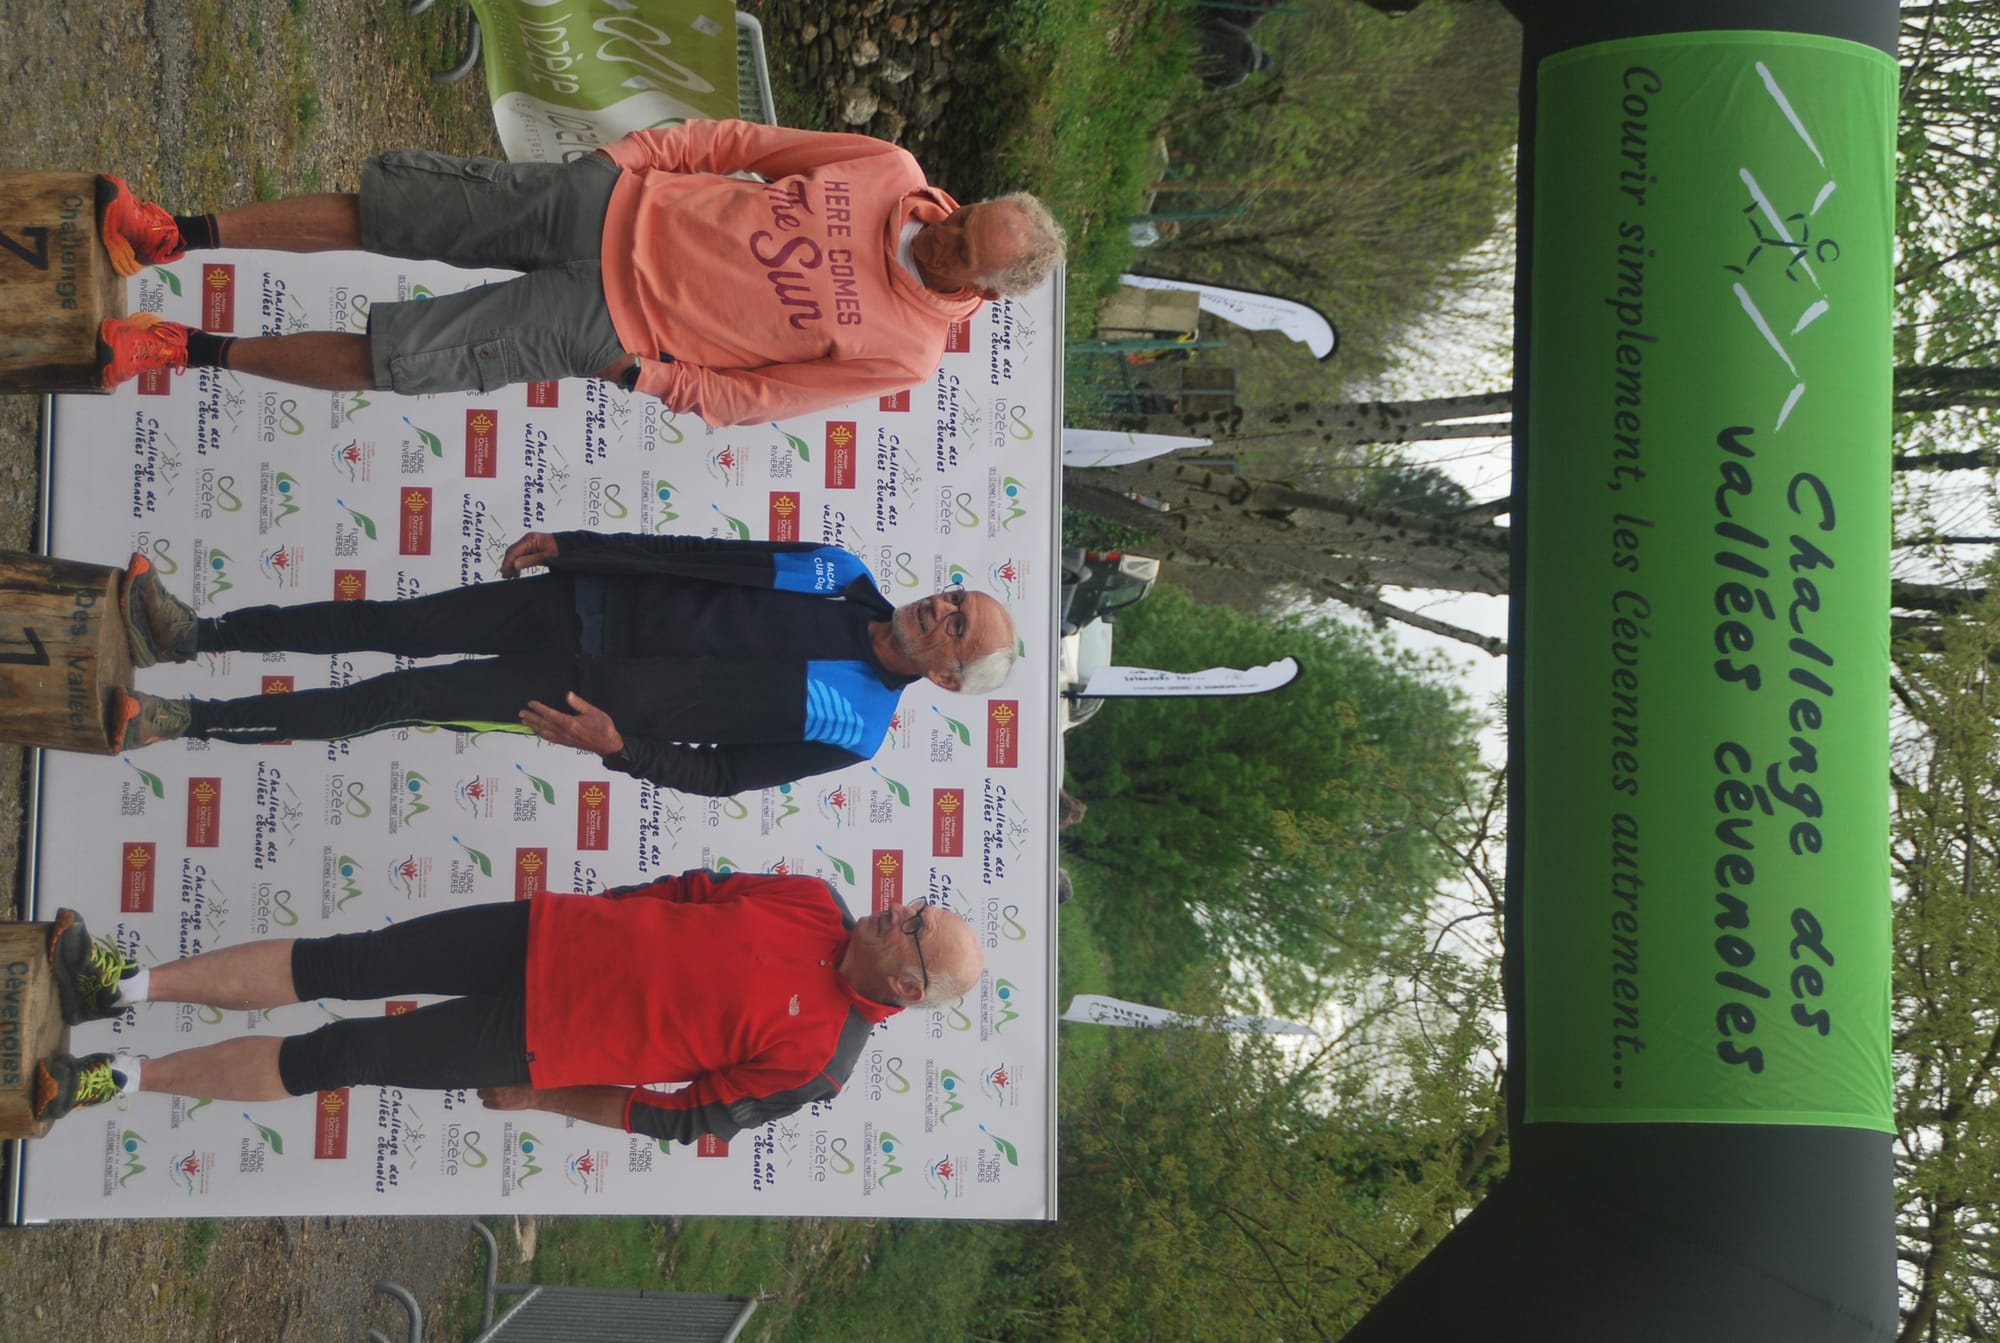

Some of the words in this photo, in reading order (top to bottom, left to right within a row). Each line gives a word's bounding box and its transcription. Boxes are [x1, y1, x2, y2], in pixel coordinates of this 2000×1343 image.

[1614, 66, 1661, 206] Courir
[762, 180, 816, 232] The
[824, 181, 851, 237] HERE
[55, 195, 84, 310] Challenge
[262, 272, 273, 316] vallées
[750, 230, 823, 330] Sun
[828, 249, 861, 325] COMES
[214, 292, 222, 329] Occitanie
[272, 280, 285, 336] Challeng
[992, 302, 1002, 324] lées
[1002, 299, 1013, 350] hallenge
[991, 332, 1001, 386] cévenoles
[1003, 359, 1012, 379] des
[1605, 221, 1654, 493] simplement,
[209, 367, 222, 420] hallenge
[937, 368, 948, 411] vallées
[946, 375, 960, 438] Challenge
[135, 411, 146, 456] vallées
[198, 400, 209, 455] cévenoles
[211, 428, 220, 449] des
[264, 392, 278, 442] lozère
[585, 410, 595, 465] cévenoles
[645, 401, 658, 451] lozère
[995, 398, 1008, 447] lozère
[145, 418, 159, 482] Challenge
[525, 423, 535, 467] vallées
[533, 430, 547, 494] Challenge
[598, 438, 607, 458] des
[877, 427, 887, 470] vallées
[885, 435, 900, 498] Challenge
[936, 419, 947, 472] cévenoles
[949, 446, 958, 466] des
[133, 463, 146, 518] cévenoles
[147, 491, 156, 512] des
[201, 468, 215, 518] lozère
[462, 494, 472, 536] vallées
[524, 475, 534, 529] cévenoles
[536, 502, 544, 522] des
[589, 477, 602, 526] lozère
[876, 478, 887, 532] cévenoles
[889, 505, 897, 525] des
[941, 485, 954, 534] lozère
[473, 501, 485, 564] Challenge
[835, 512, 844, 547] Chall
[1611, 514, 1653, 572] les
[461, 545, 471, 586] cévenol
[880, 545, 893, 594] lozère
[1714, 427, 1778, 692] vallées
[70, 592, 96, 636] Des
[0, 627, 50, 665] 1
[1766, 472, 1836, 856] Challenge
[1609, 591, 1654, 794] Cévennes
[137, 786, 145, 816] FLORAC
[257, 761, 268, 806] vallées
[266, 768, 280, 833] Challenge
[330, 774, 345, 825] lozère
[984, 778, 994, 822] vallées
[589, 810, 597, 847] Occitanie
[649, 784, 661, 836] hallenge
[993, 785, 1006, 849] Challenge
[254, 814, 268, 870] cévenoles
[268, 841, 277, 862] des
[639, 818, 649, 873] cévenoles
[652, 845, 660, 866] des
[983, 830, 994, 885] cévenoles
[134, 871, 142, 909] Occitanie
[182, 858, 192, 902] vallées
[929, 867, 939, 906] vallée
[942, 874, 951, 911] Chall
[996, 857, 1004, 878] des
[190, 865, 206, 930] Challenge
[257, 883, 272, 934] lozère
[1714, 741, 1779, 1073] cévenoles
[192, 939, 202, 954] de
[987, 898, 1000, 948] lozère
[1609, 812, 1648, 1092] autrement...
[1789, 907, 1832, 1036] des
[2, 961, 30, 1084] Cévenoles
[870, 1050, 885, 1101] lozère
[327, 1117, 335, 1155] Occitanie
[388, 1090, 402, 1156] Challenge
[248, 1150, 256, 1172] TROIS
[256, 1142, 264, 1172] FLORAC
[376, 1136, 388, 1193] cévenoles
[390, 1164, 399, 1186] des
[447, 1124, 461, 1176] lozère
[644, 1143, 652, 1172] FLORAC
[753, 1136, 764, 1191] cévenoles
[766, 1163, 775, 1184] des
[815, 1130, 828, 1182] lozère
